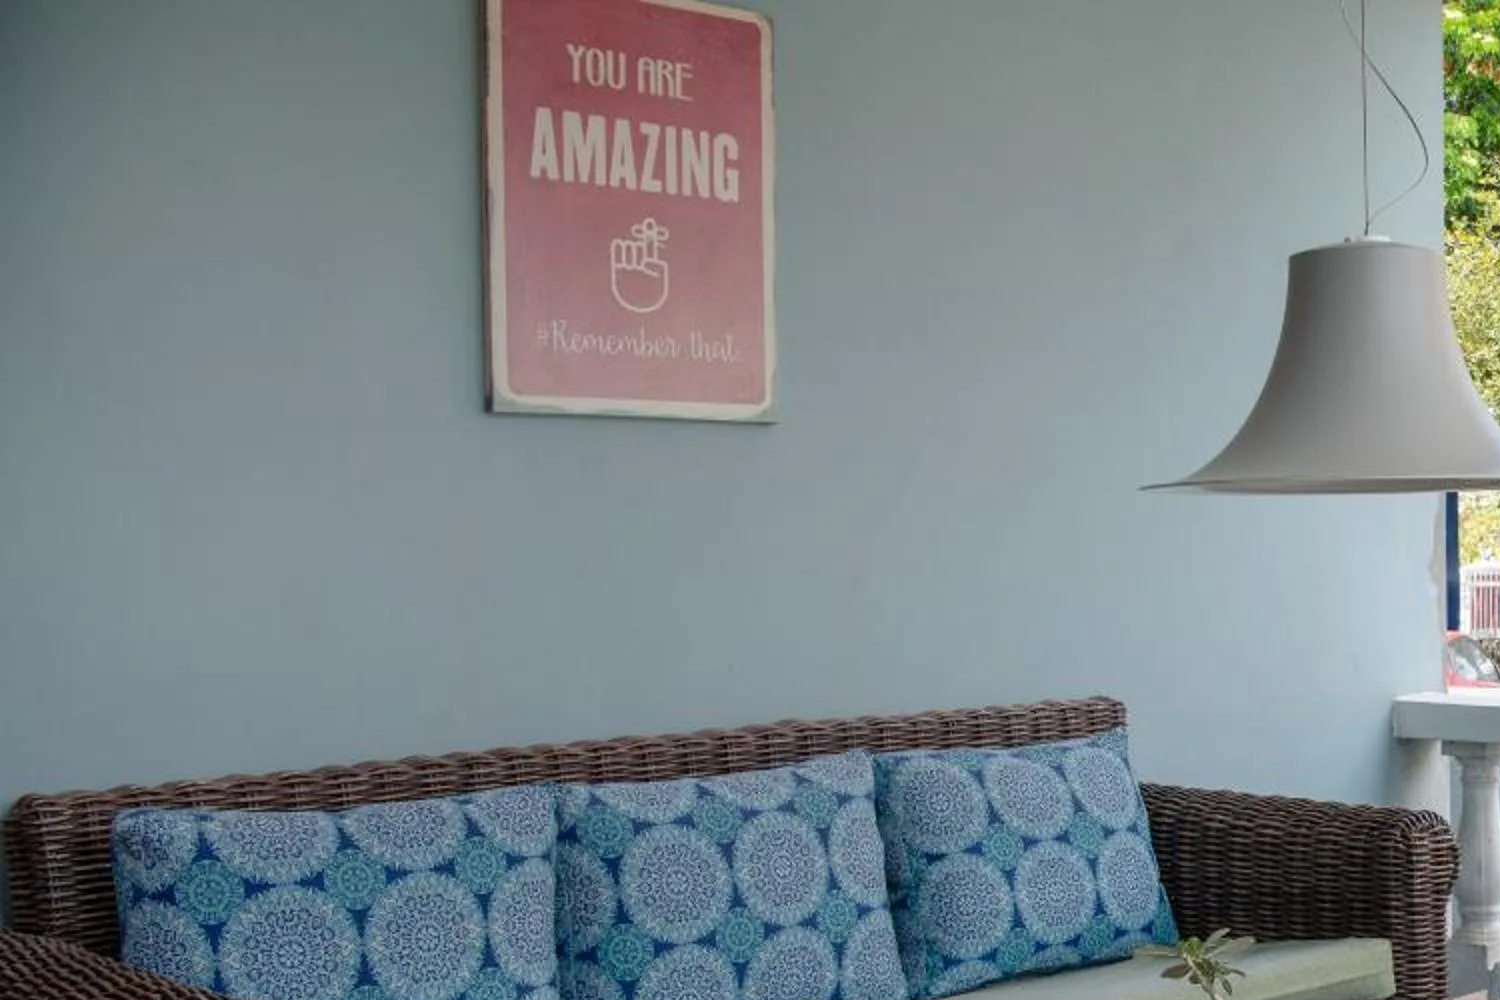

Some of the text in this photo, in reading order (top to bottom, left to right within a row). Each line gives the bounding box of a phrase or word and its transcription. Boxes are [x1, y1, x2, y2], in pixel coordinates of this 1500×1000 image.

[565, 43, 694, 101] YOU ARE
[530, 106, 739, 203] AMAZING
[536, 319, 737, 363] #Remember that
